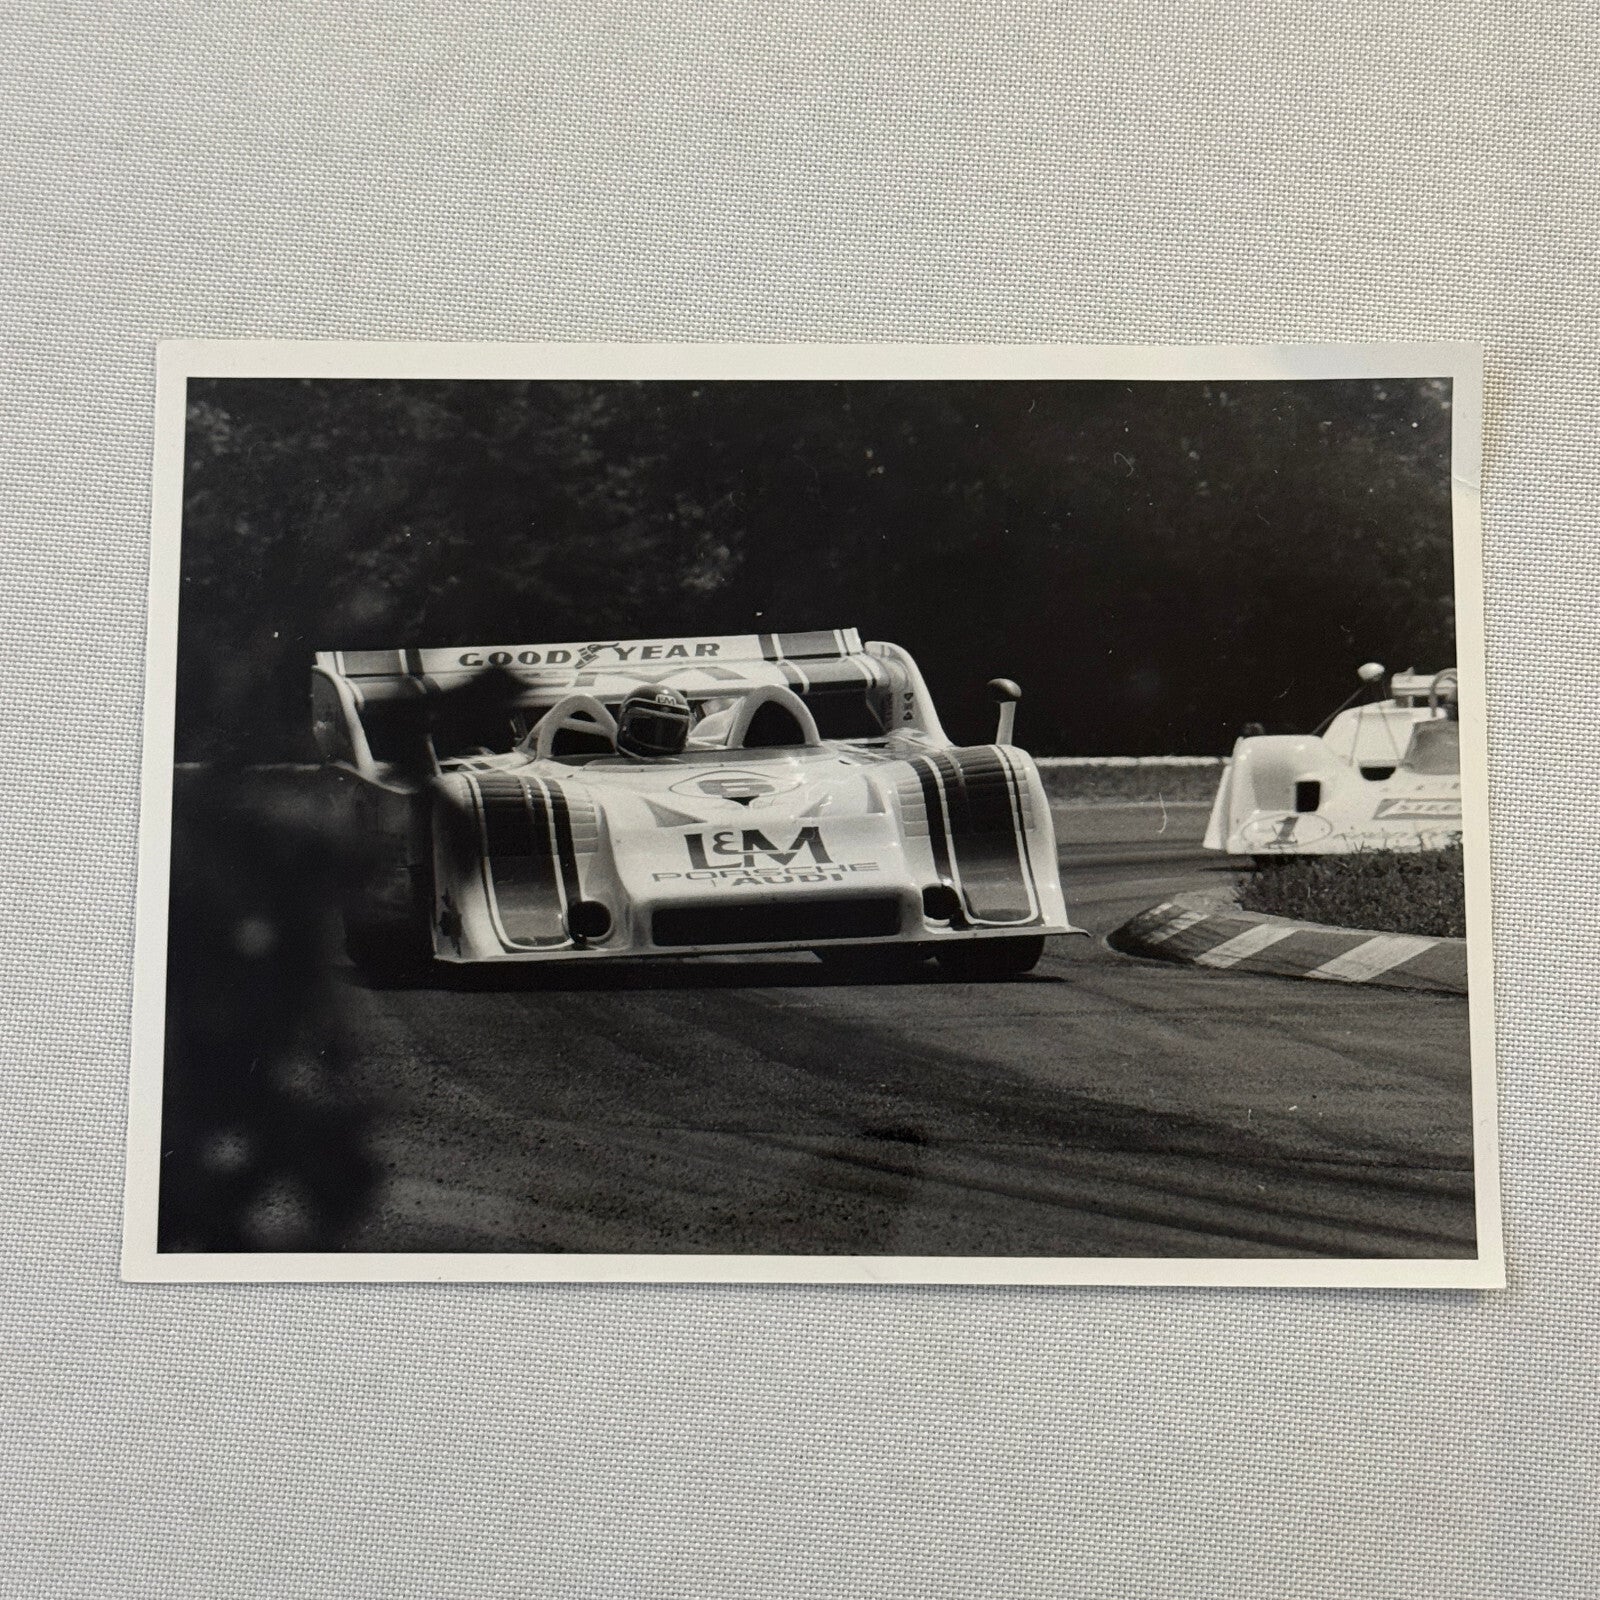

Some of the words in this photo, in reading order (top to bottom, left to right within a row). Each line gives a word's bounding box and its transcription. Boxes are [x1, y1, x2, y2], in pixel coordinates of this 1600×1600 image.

[458, 649, 572, 667] GOOD
[614, 643, 720, 661] YEAR
[1264, 816, 1299, 848] 1
[684, 826, 834, 870] L&M
[651, 861, 880, 882] PORSCHE
[732, 873, 844, 887] AUDI
